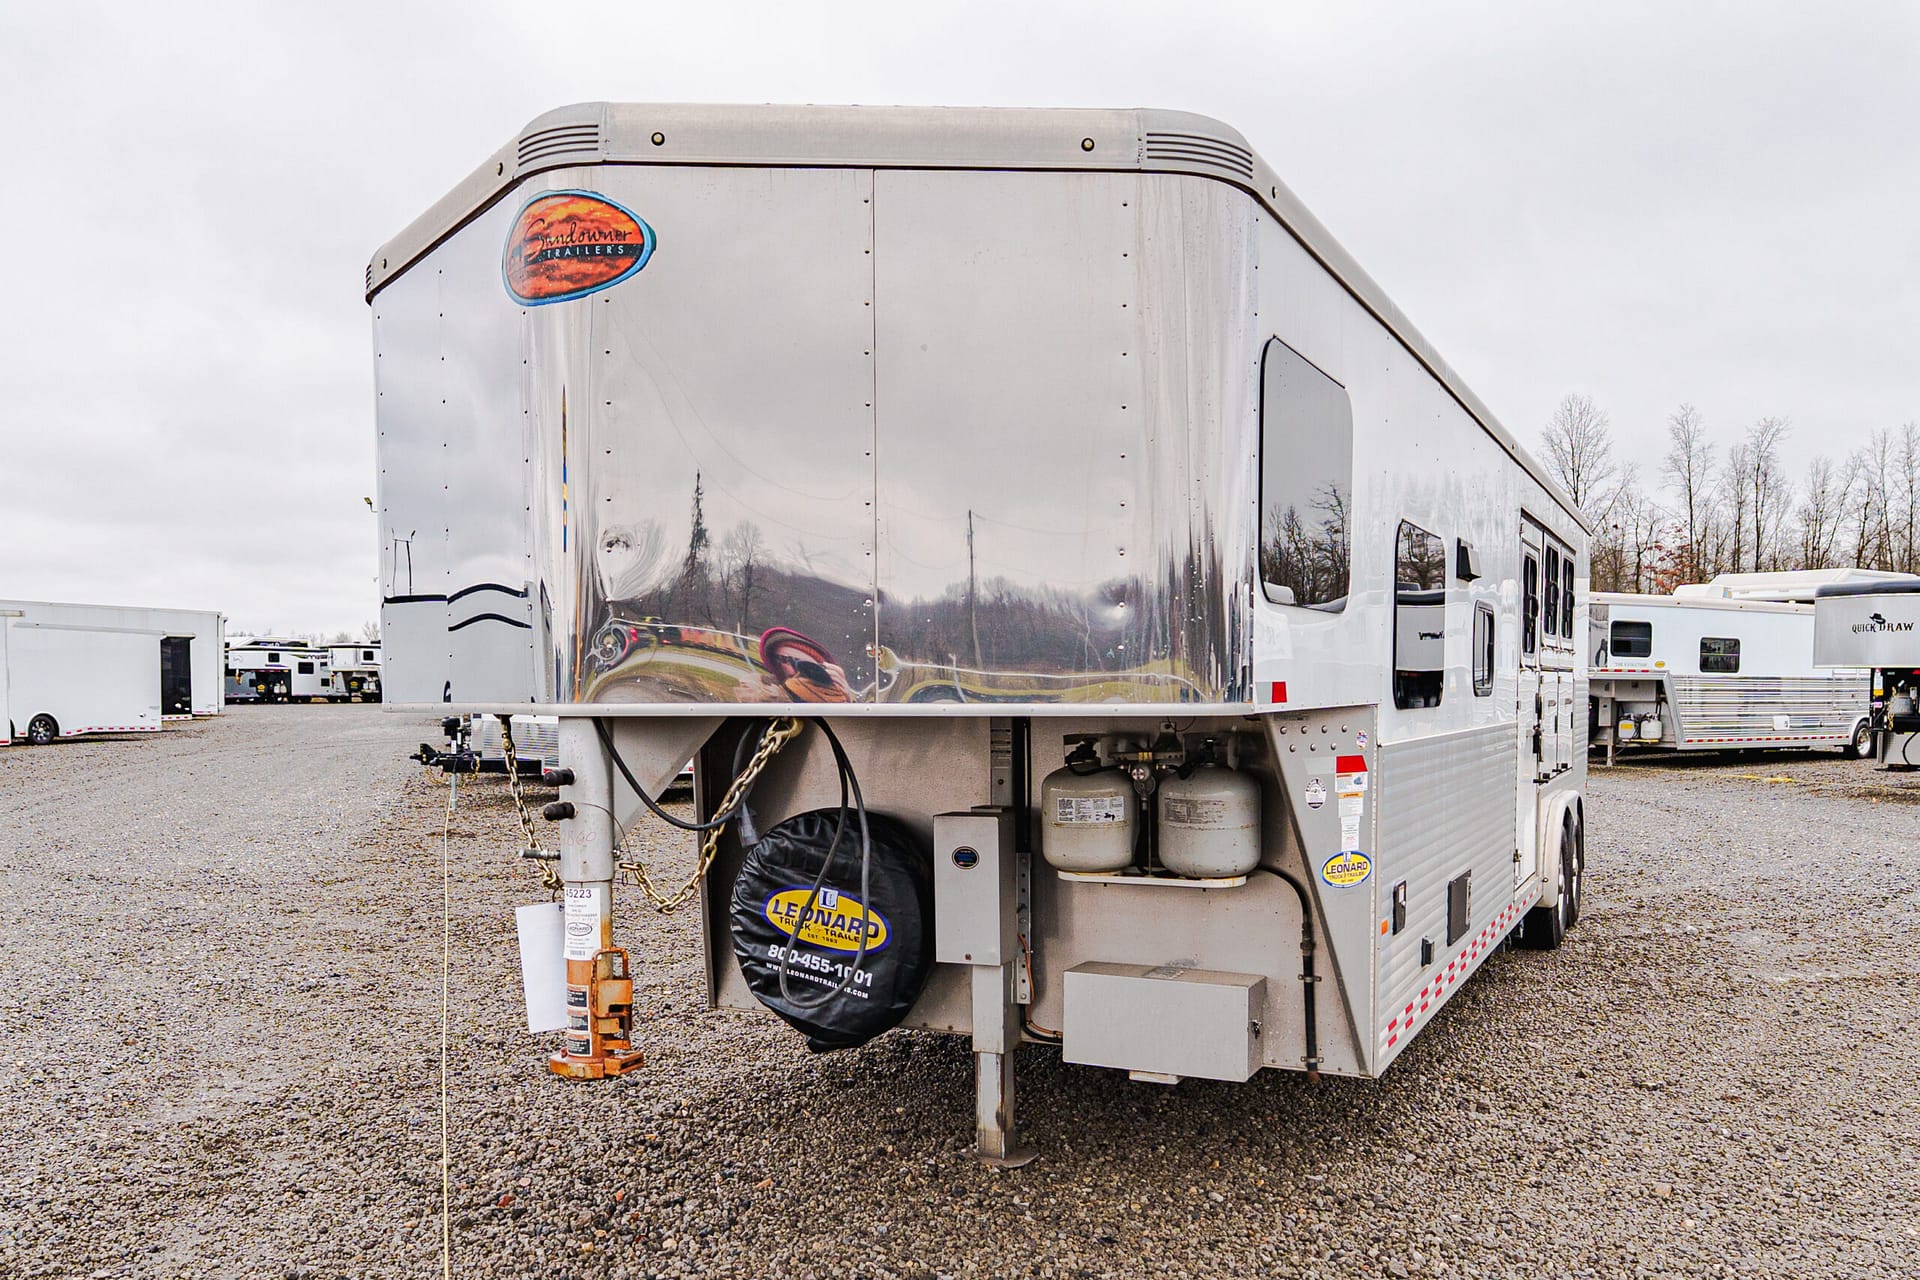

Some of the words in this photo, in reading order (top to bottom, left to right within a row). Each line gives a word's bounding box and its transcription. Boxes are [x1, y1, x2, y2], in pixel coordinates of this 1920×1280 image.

[523, 218, 632, 262] Sundowner
[546, 245, 625, 259] TRAILERS
[1851, 623, 1876, 634] QUICK
[1879, 622, 1914, 632] DRAW
[1326, 861, 1368, 875] LEONARD
[772, 899, 880, 939] LEONARD
[779, 916, 812, 932] TRUK
[824, 928, 868, 944] TRAILE
[768, 944, 873, 987] 800-455-1001
